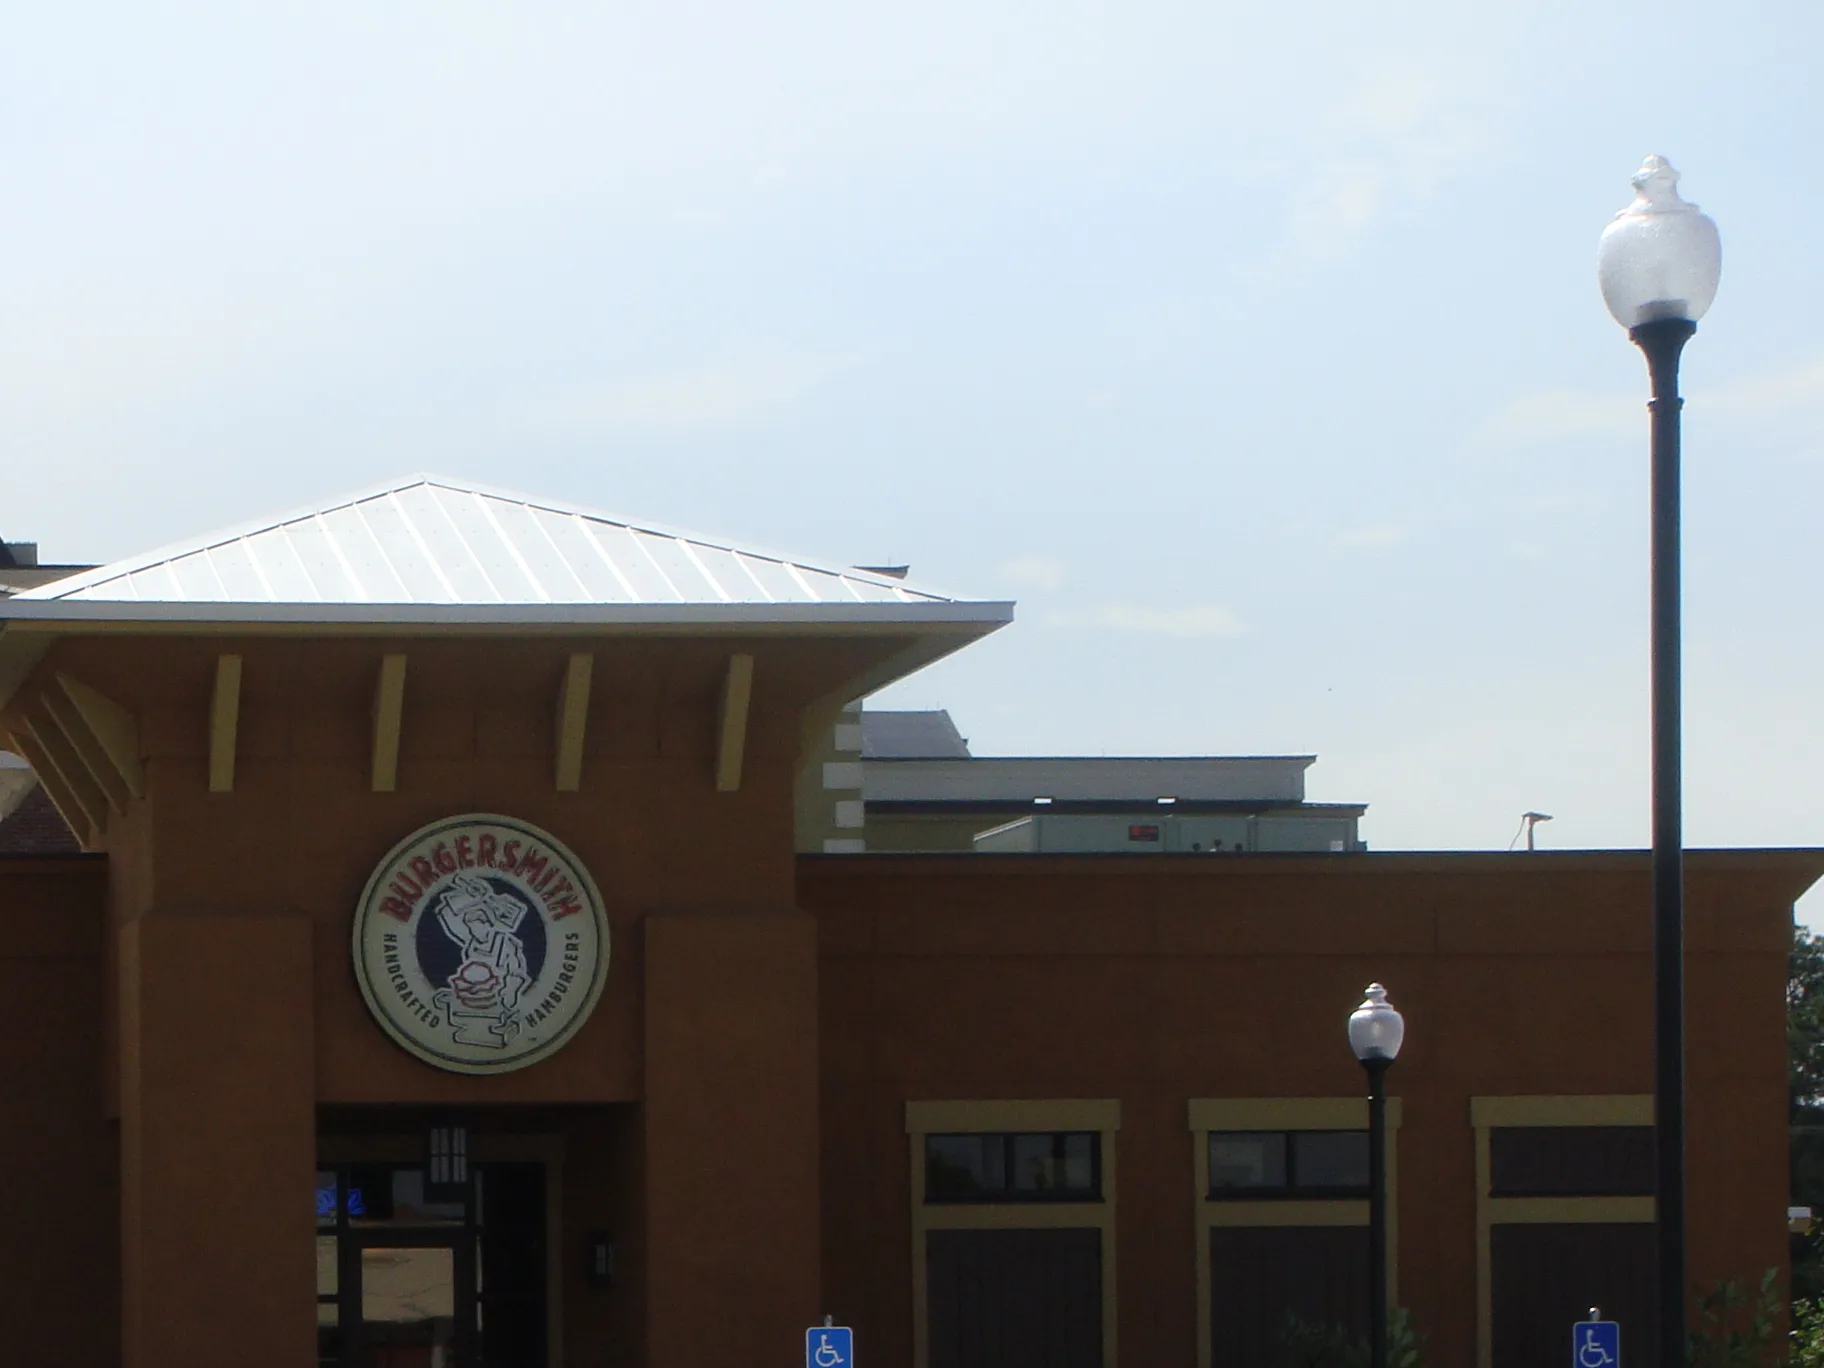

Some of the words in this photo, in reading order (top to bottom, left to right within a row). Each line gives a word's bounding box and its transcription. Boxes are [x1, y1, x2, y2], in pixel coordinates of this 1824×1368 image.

[379, 833, 583, 923] BURGERSMITH
[383, 932, 441, 1029] HANDCRAFTED
[526, 931, 580, 1028] HAMBURGERS
